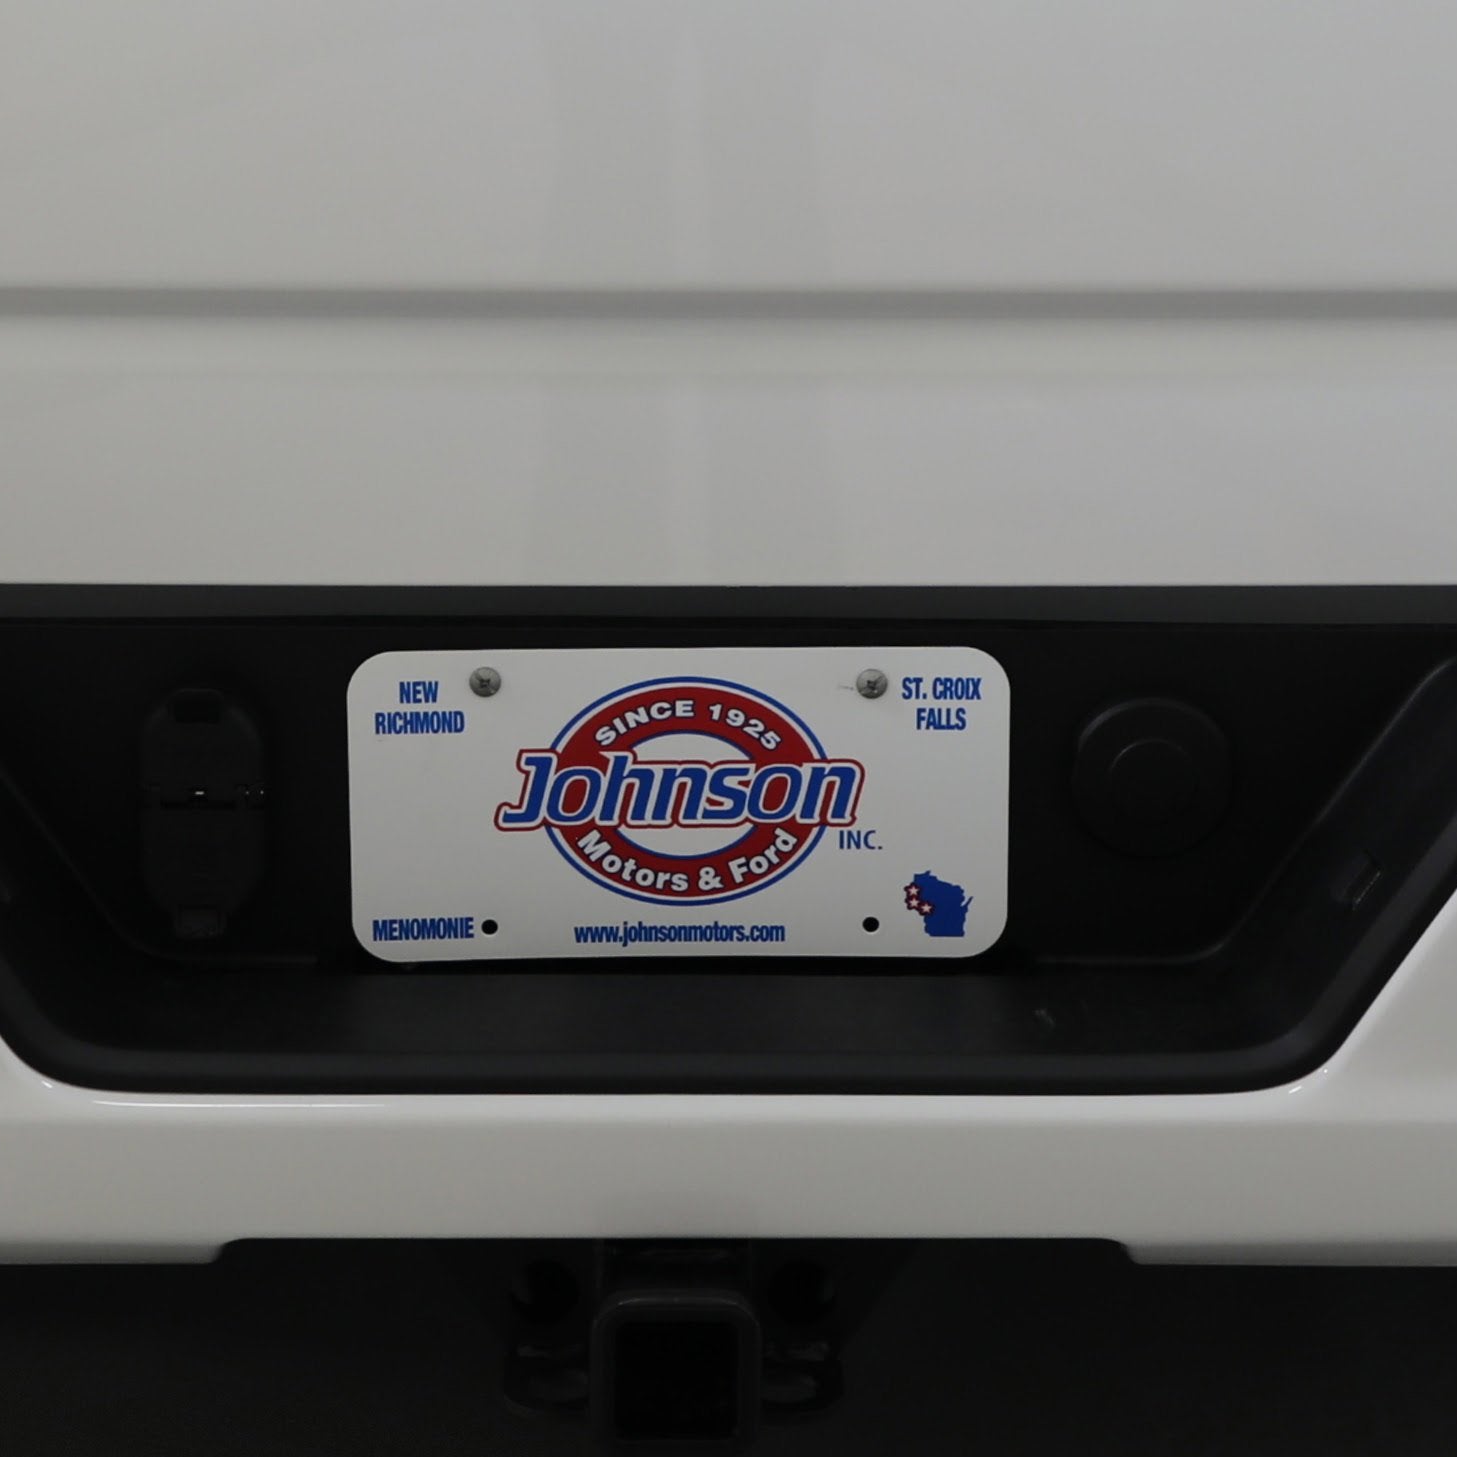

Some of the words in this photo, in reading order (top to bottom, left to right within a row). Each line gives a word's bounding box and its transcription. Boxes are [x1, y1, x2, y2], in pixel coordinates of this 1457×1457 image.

[399, 681, 439, 704] NEW
[902, 678, 928, 701] ST.
[933, 677, 982, 701] CROIX
[374, 710, 465, 735] RICHMOND
[594, 699, 695, 746] SINCE
[708, 703, 782, 751] 1925
[916, 708, 967, 731] FALLS
[494, 749, 865, 832] Johnson
[838, 830, 884, 850] INC.
[576, 829, 689, 892] Motors
[697, 866, 724, 892] &
[728, 827, 798, 884] Ford
[372, 917, 475, 941] MENOMONIE
[574, 921, 786, 947] www.johnsonmotors.com
